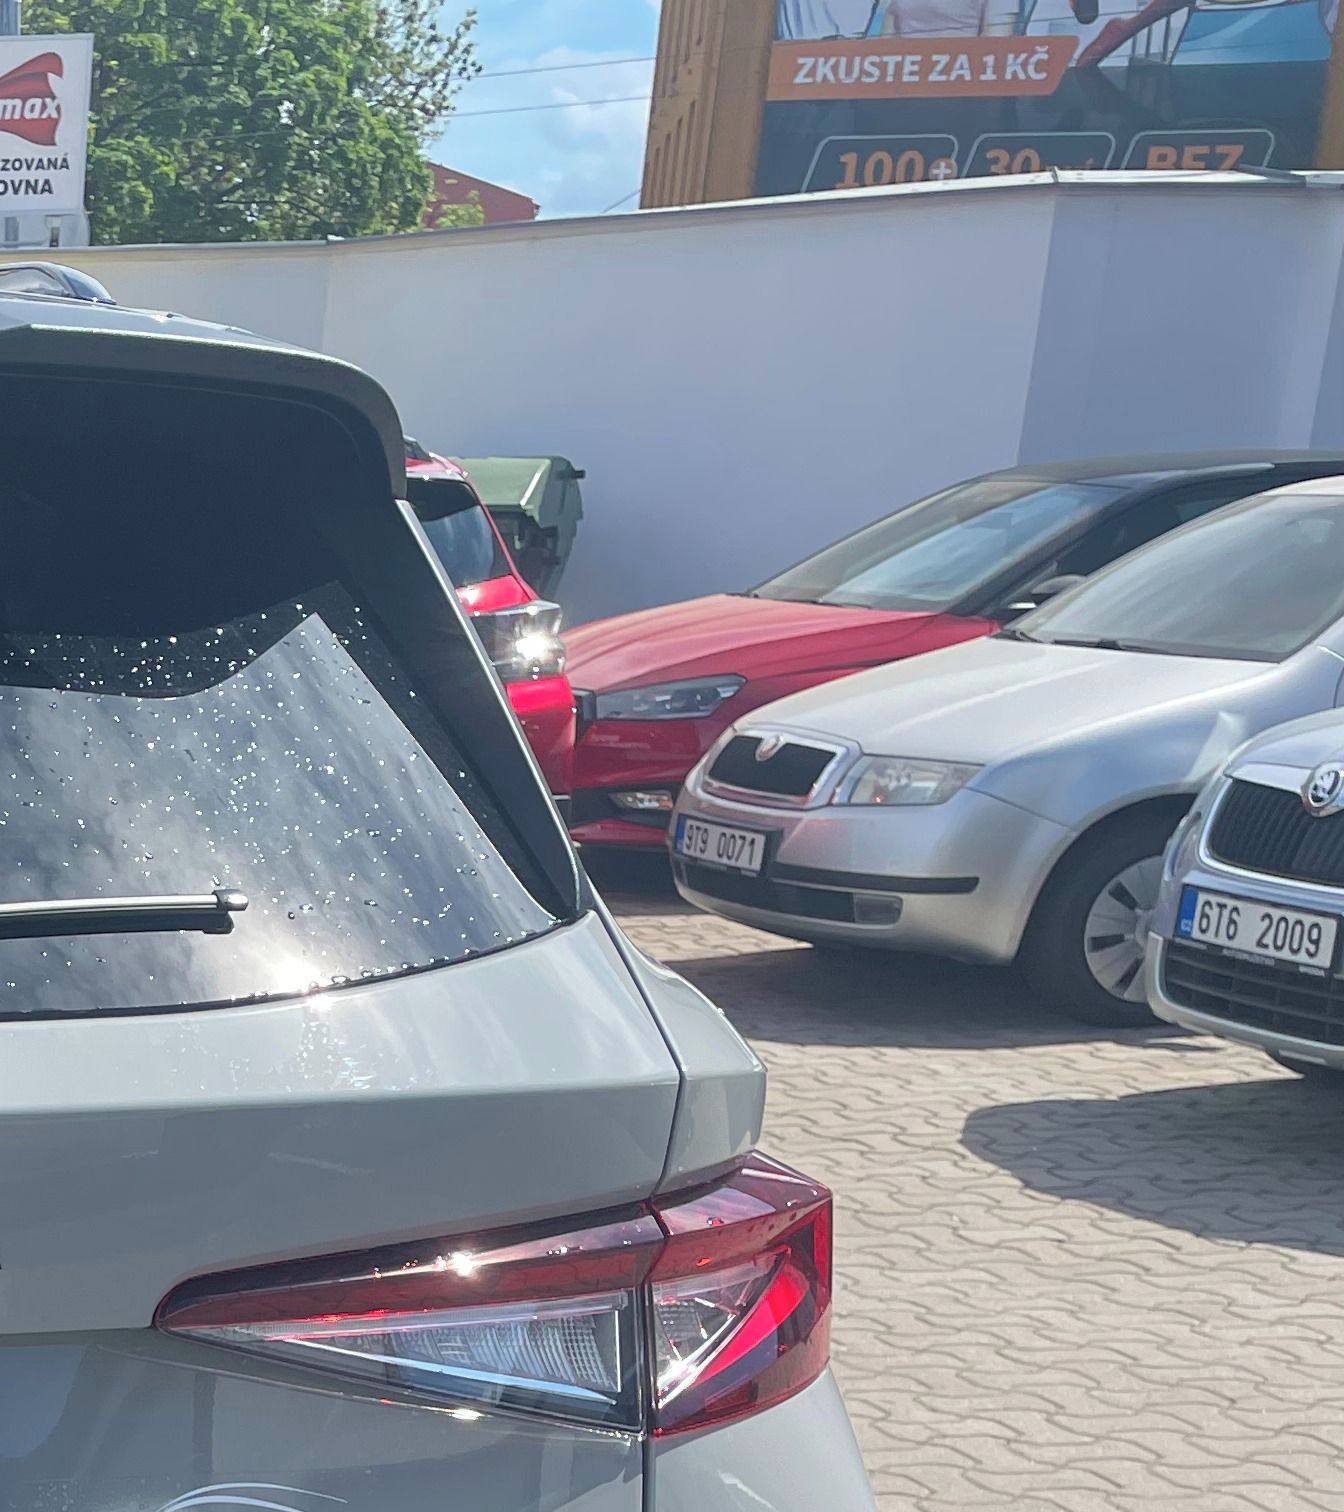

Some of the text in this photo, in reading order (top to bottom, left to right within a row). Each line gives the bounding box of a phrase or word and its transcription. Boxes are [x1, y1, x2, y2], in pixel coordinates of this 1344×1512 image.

[793, 45, 1049, 85] ZKUSTE ZA 1 KČ
[717, 831, 756, 866] 0071
[1198, 899, 1241, 941] 6T6
[1256, 912, 1322, 958] 2009
